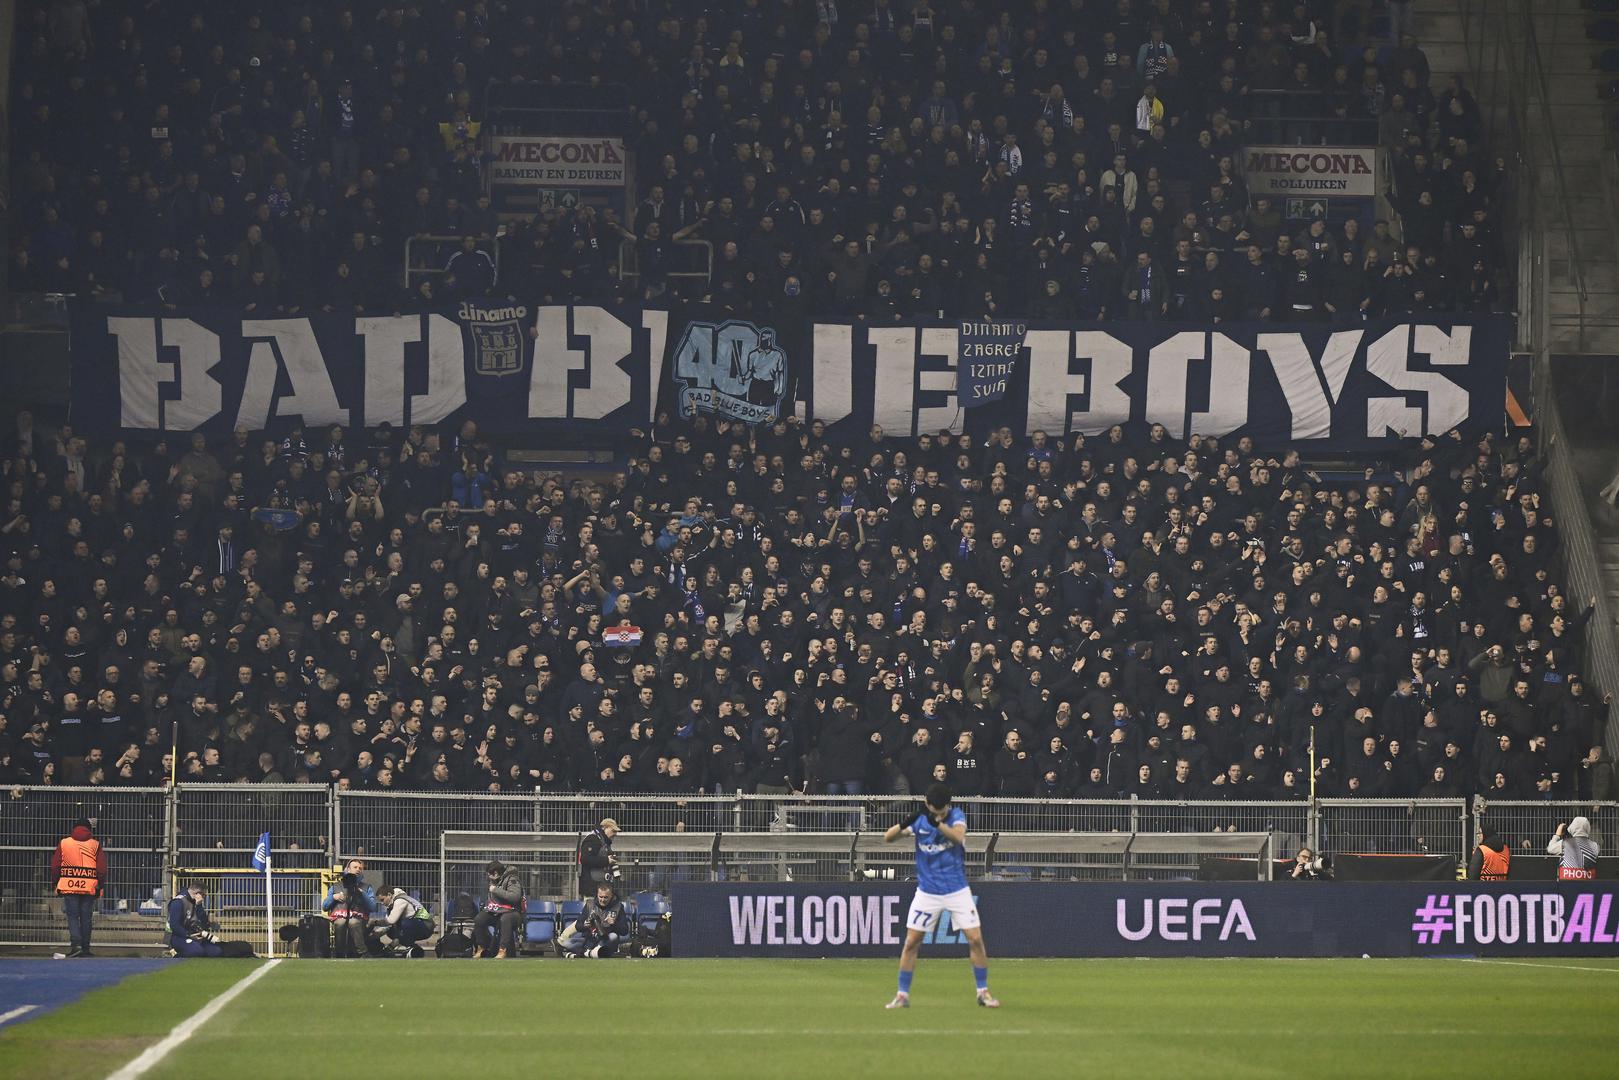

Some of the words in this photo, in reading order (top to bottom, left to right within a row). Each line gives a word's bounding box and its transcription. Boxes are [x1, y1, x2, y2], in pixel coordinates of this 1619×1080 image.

[497, 142, 622, 164] MECONA
[1248, 153, 1372, 174] MECONA
[495, 169, 543, 179] RAMEN
[547, 169, 564, 179] EN
[568, 170, 622, 180] DEUREN
[1270, 179, 1347, 190] ROLLUIKEN
[458, 301, 527, 321] dinamo
[962, 322, 1026, 336] DINAMO
[677, 324, 760, 396] 40
[107, 313, 467, 431] BAD
[528, 305, 965, 437] BE
[1022, 323, 1472, 440] BOYS
[68, 879, 86, 889] 042
[1563, 869, 1592, 880] PHOTO
[728, 895, 900, 945] WELCOME
[913, 910, 932, 927] 77
[1117, 899, 1256, 941] UEFA
[1412, 893, 1619, 945] #FOOTBAL
